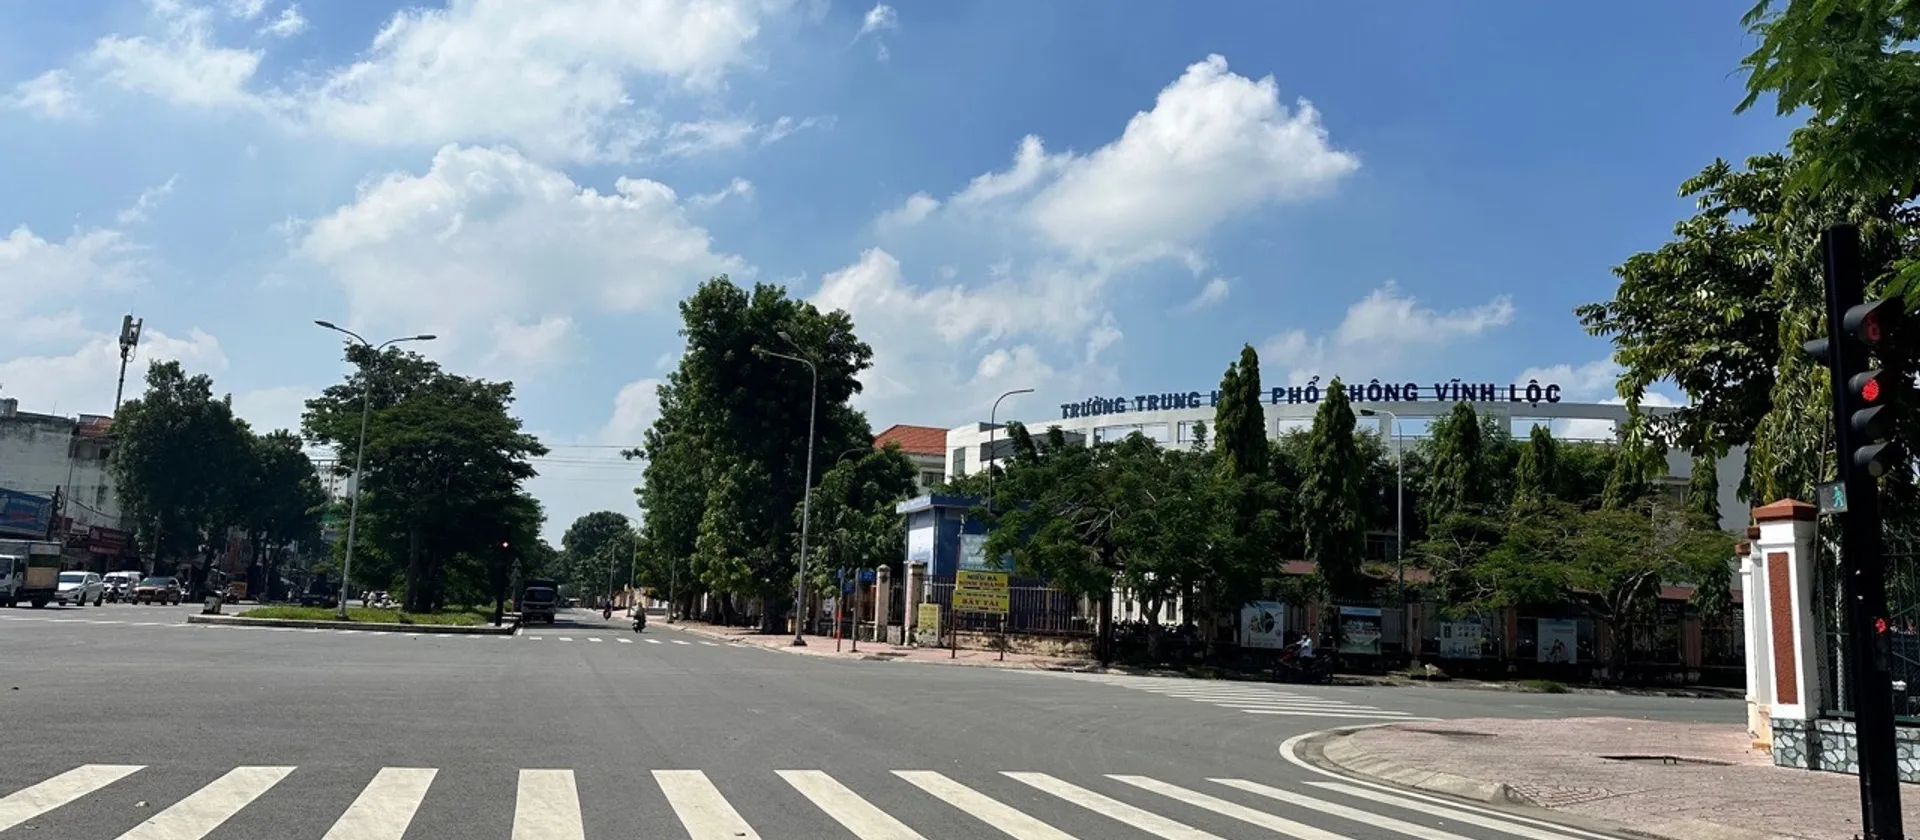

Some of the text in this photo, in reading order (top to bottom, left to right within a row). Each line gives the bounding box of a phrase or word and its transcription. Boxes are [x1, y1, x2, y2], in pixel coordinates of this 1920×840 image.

[1060, 395, 1126, 419] TRƯỜNG
[1134, 391, 1201, 412] TRUNG
[1272, 375, 1320, 404] PHỔ
[1349, 378, 1419, 402] HÔNG
[1434, 378, 1495, 402] VĨNH
[1509, 379, 1561, 407] LỘC
